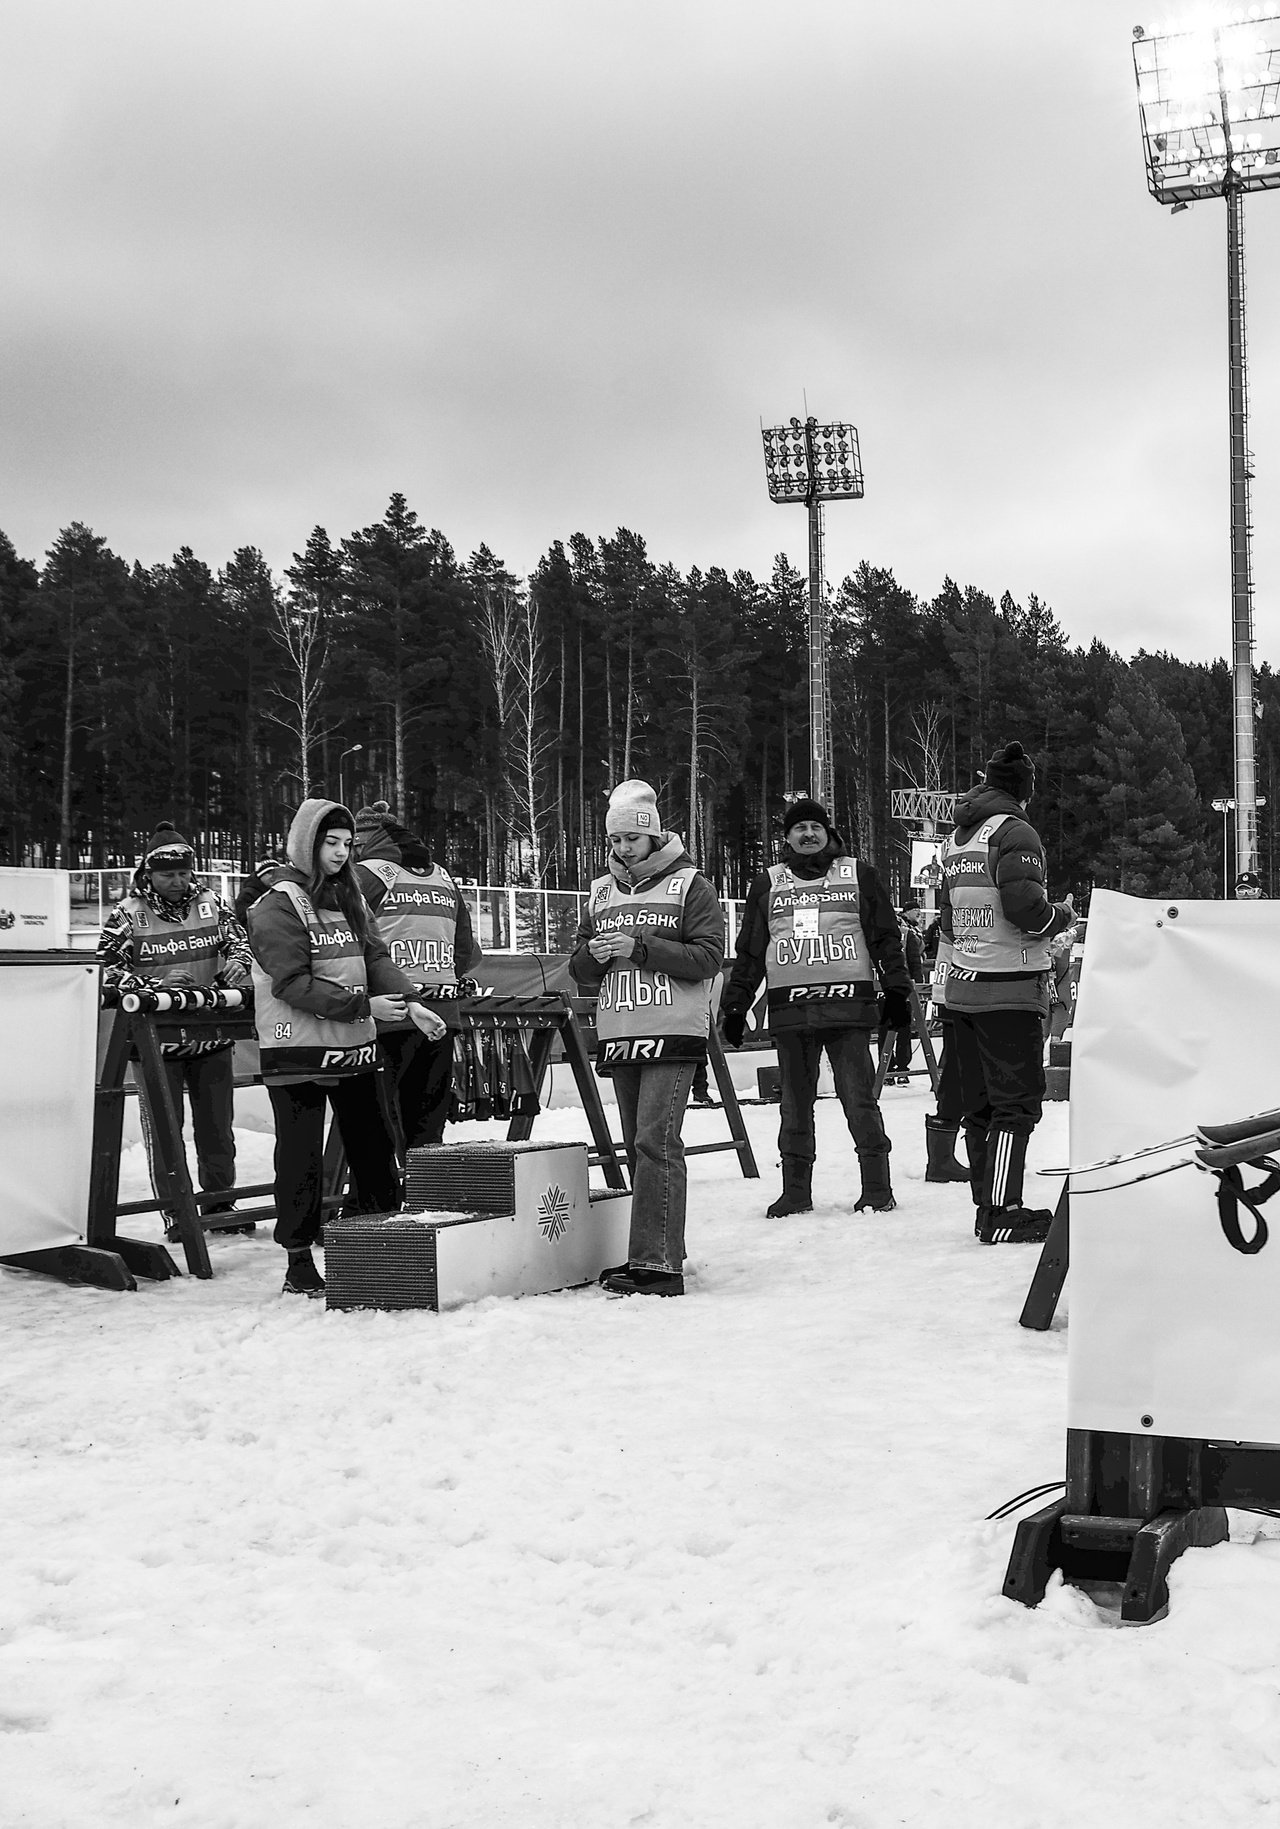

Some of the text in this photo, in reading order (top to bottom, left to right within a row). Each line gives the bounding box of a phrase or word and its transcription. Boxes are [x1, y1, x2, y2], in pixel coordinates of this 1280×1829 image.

[961, 859, 985, 874] Банк
[636, 909, 679, 929] Банк
[140, 935, 219, 956] Альфа Банк
[775, 934, 858, 966] СУДЬЯ
[1020, 948, 1028, 964] 1
[789, 983, 855, 1002] PARI
[275, 1022, 292, 1039] 84
[320, 1043, 376, 1068] PARI
[604, 1038, 665, 1062] PARI
